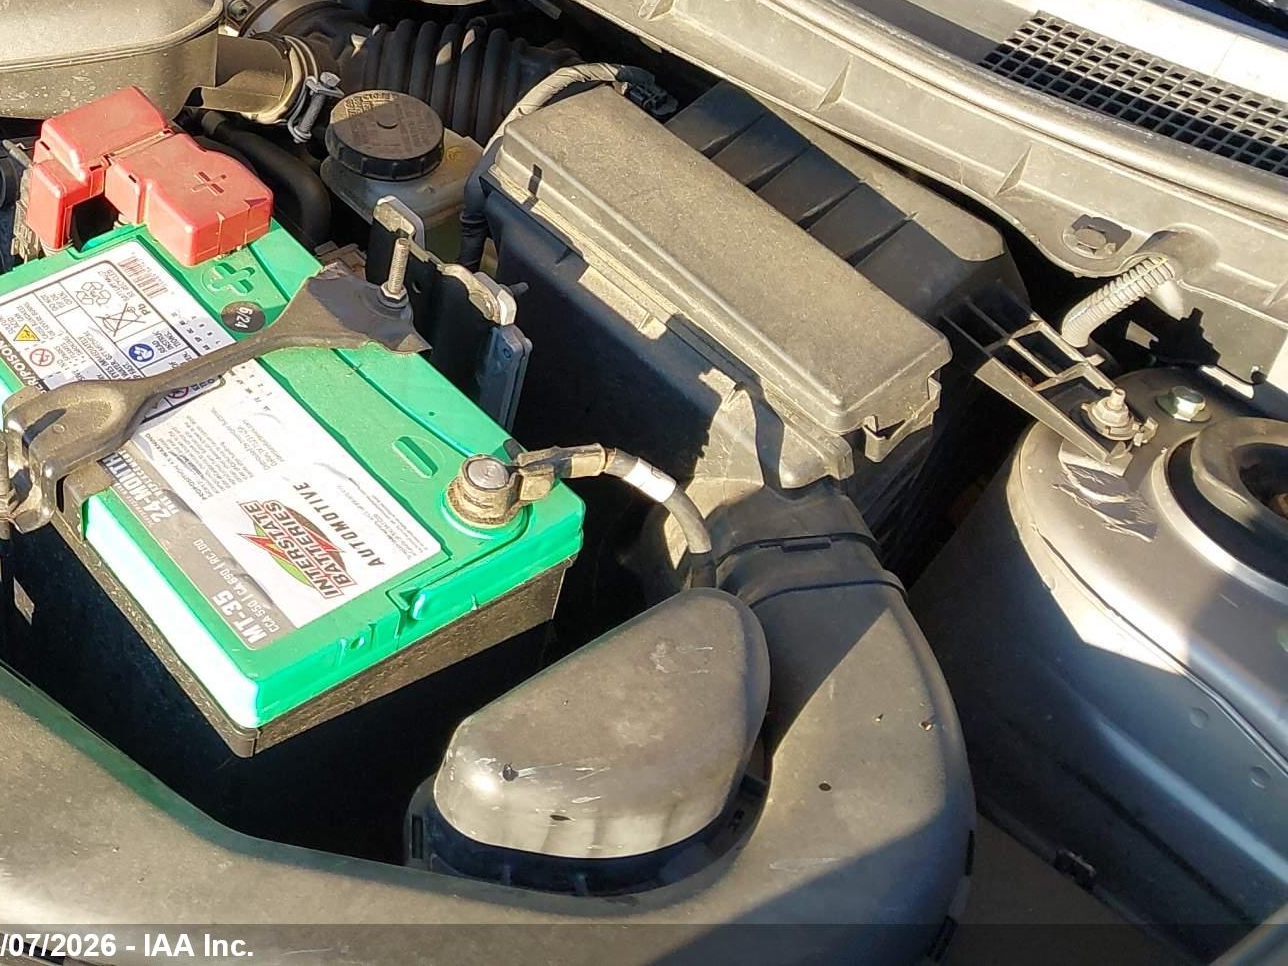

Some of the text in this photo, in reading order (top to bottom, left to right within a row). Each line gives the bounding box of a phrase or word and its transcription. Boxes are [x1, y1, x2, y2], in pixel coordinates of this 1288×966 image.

[135, 303, 151, 316] Pb
[234, 306, 253, 329] 6/24
[104, 366, 120, 379] EYES
[102, 452, 172, 524] 24-MONTH
[243, 501, 339, 599] INTERSTATE
[264, 499, 353, 589] BATTERIES
[292, 479, 386, 571] AUTOMOTIVE
[192, 538, 281, 634] CCA 550 CA 690 RC 100
[211, 589, 268, 644] MT-35
